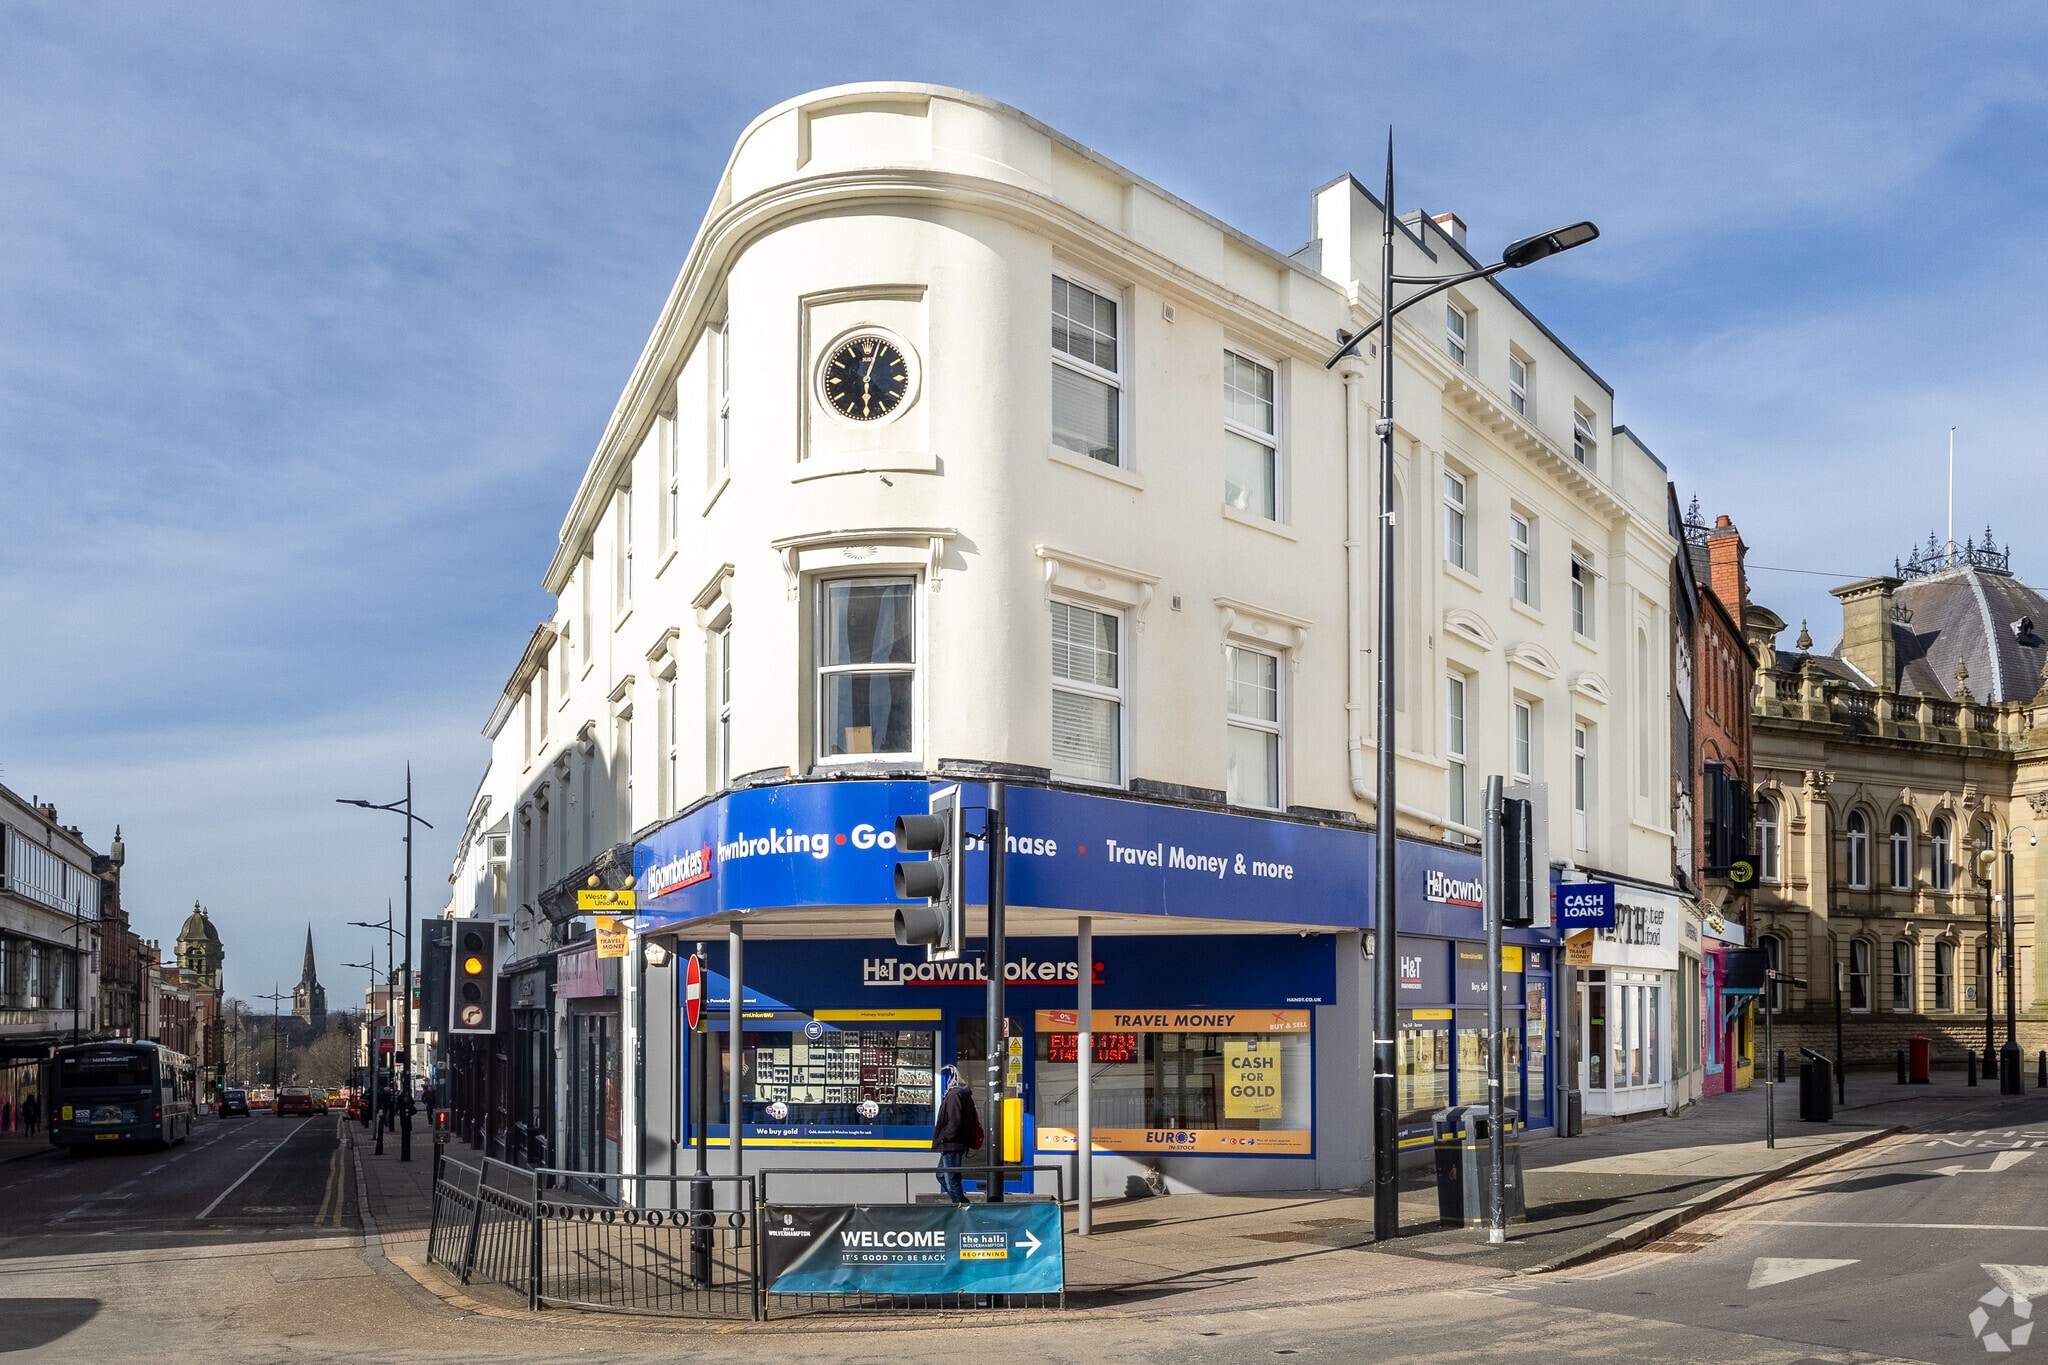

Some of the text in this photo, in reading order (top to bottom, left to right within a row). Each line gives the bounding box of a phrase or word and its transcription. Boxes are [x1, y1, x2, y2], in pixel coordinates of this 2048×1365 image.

[1106, 839, 1294, 880] Travel Money & more
[1564, 894, 1604, 907] CASH
[1564, 907, 1604, 917] LOANS
[1401, 956, 1422, 978] H&T
[1059, 1013, 1071, 1021] 0%
[1114, 1015, 1235, 1027] TRAVEL MONEY
[1270, 1022, 1284, 1030] BUY
[1293, 1021, 1308, 1029] SELL
[1231, 1056, 1274, 1069] CASH
[1241, 1072, 1264, 1081] FOR
[1230, 1085, 1275, 1097] GOLD
[756, 1127, 798, 1136] We buy gold
[841, 1230, 946, 1247] WELCOME
[962, 1234, 1005, 1243] the halls
[922, 1253, 946, 1261] BACK
